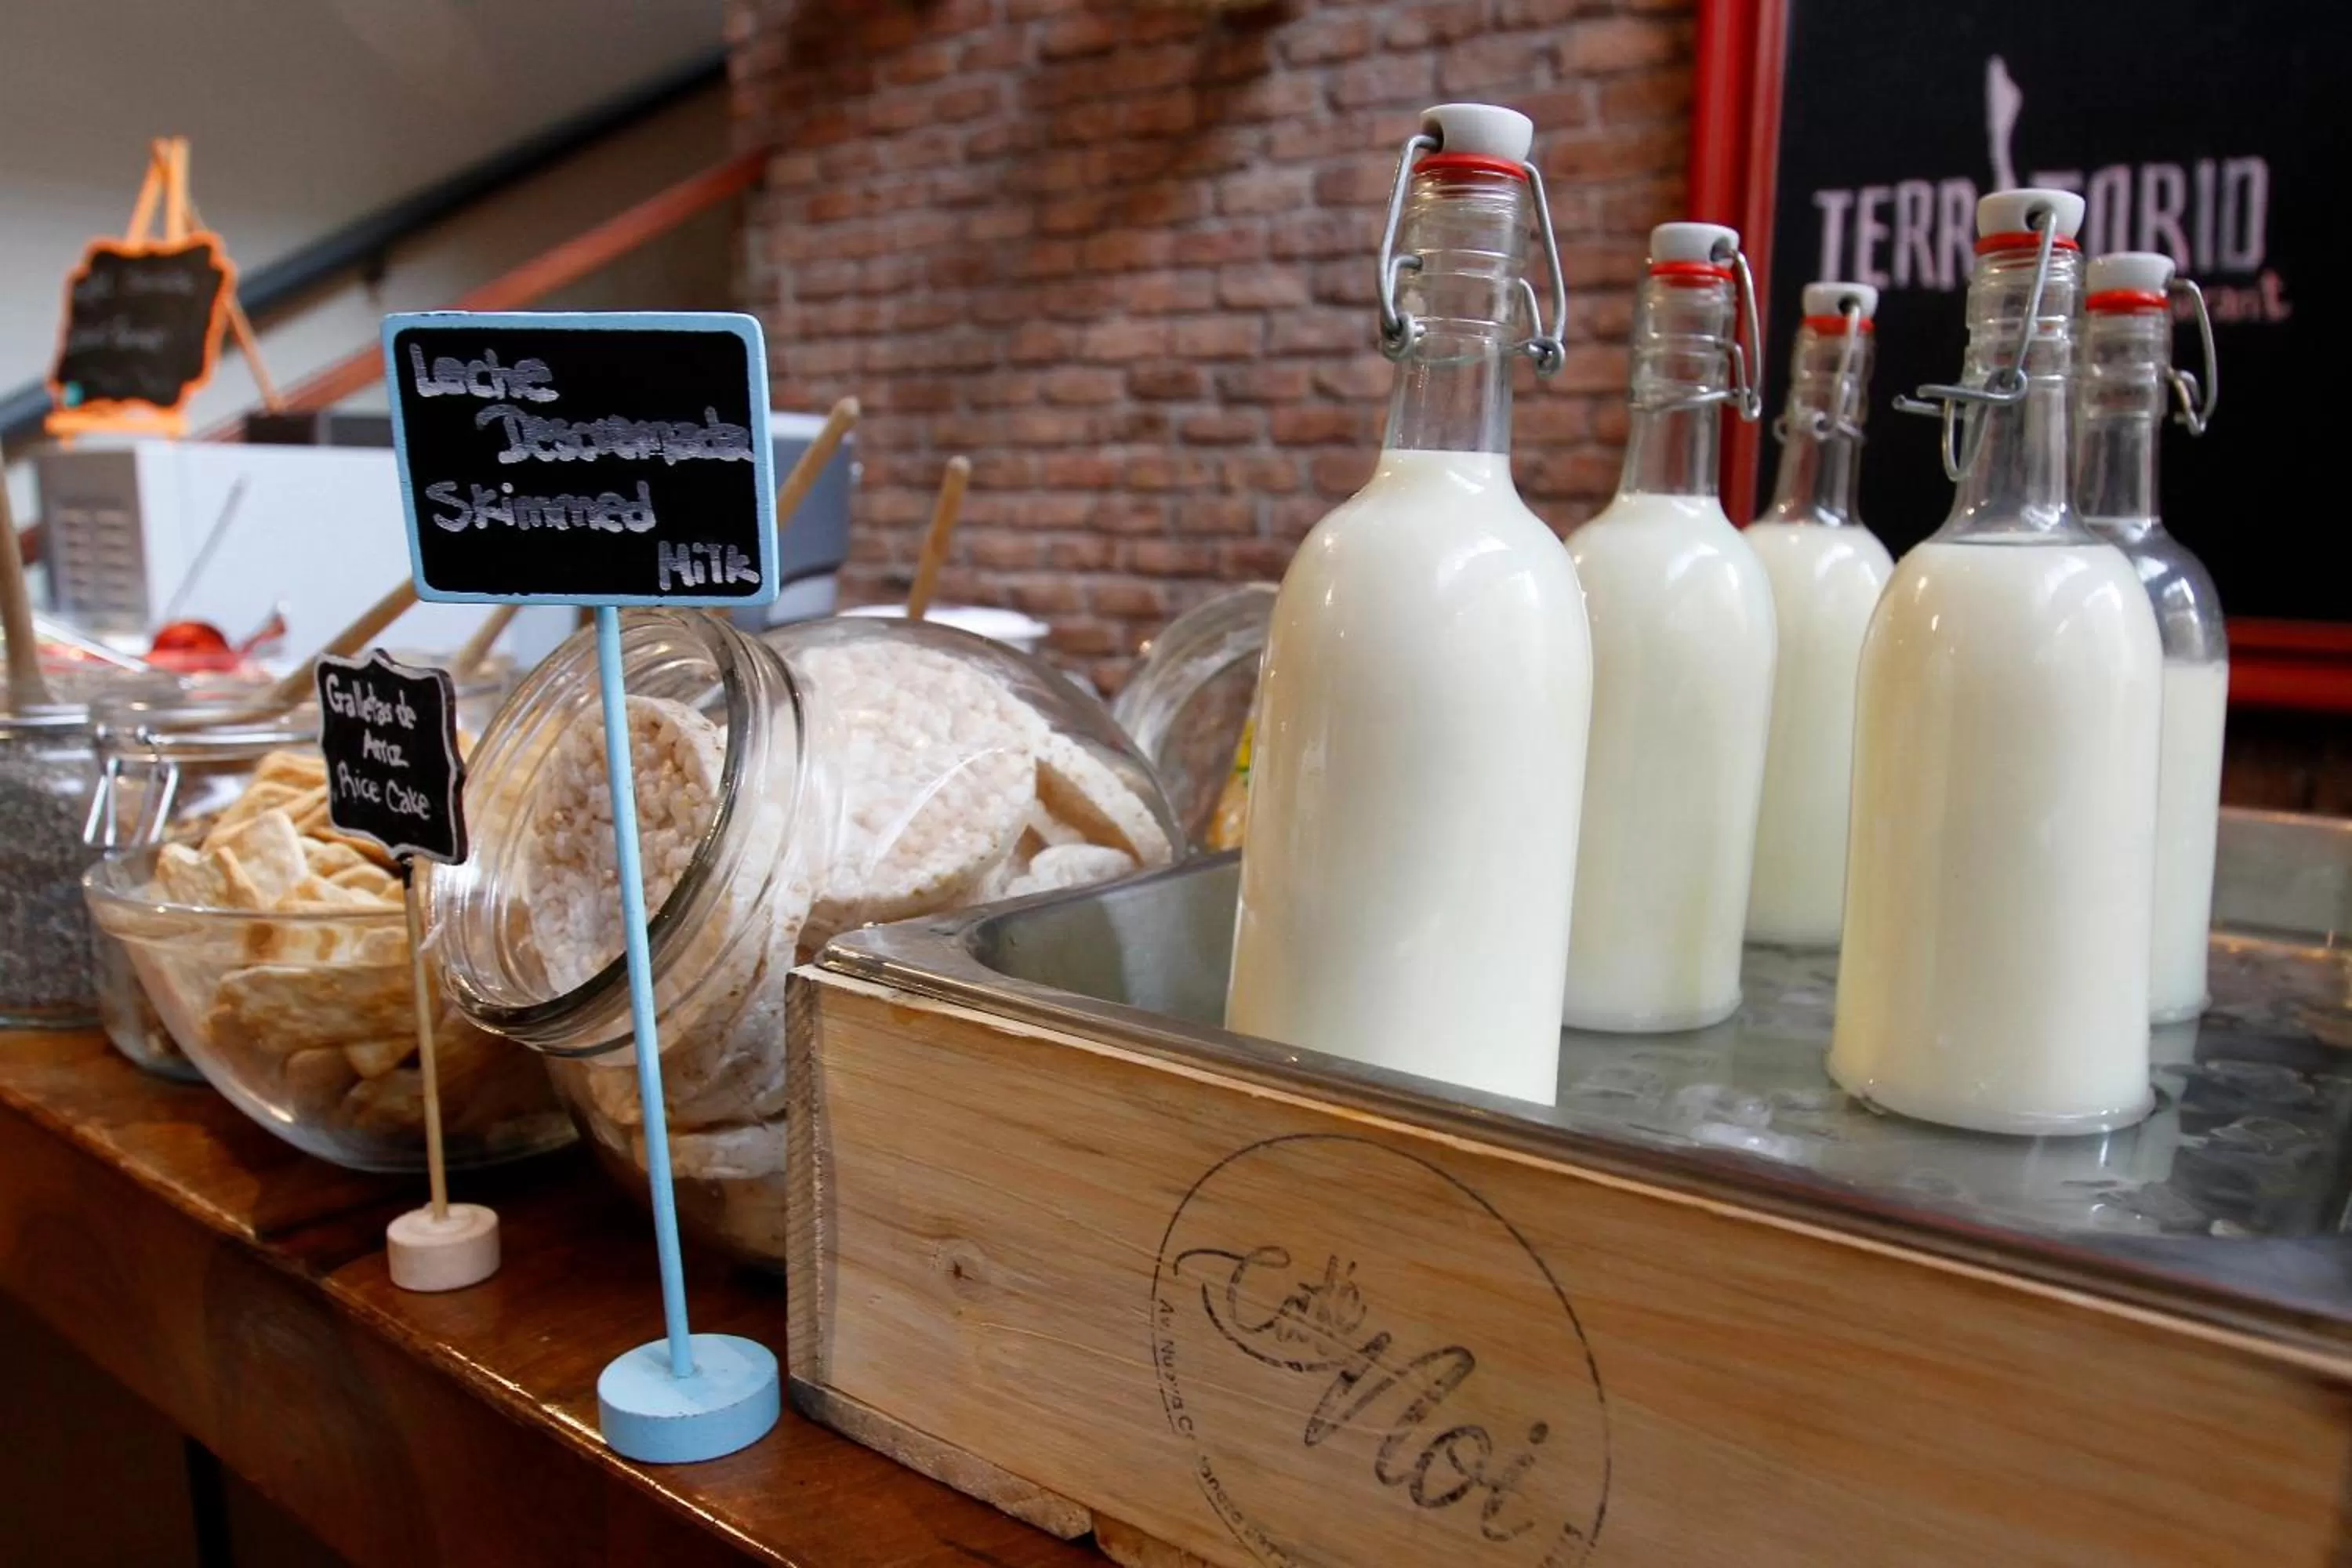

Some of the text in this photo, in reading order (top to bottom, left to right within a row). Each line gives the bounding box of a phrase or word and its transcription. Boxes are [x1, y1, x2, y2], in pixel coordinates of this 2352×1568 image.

[409, 343, 560, 402] Leche
[426, 480, 657, 532] Skimmed
[658, 540, 760, 590] Milk
[325, 672, 418, 730] Galletas de
[337, 759, 431, 821] Rice Cake
